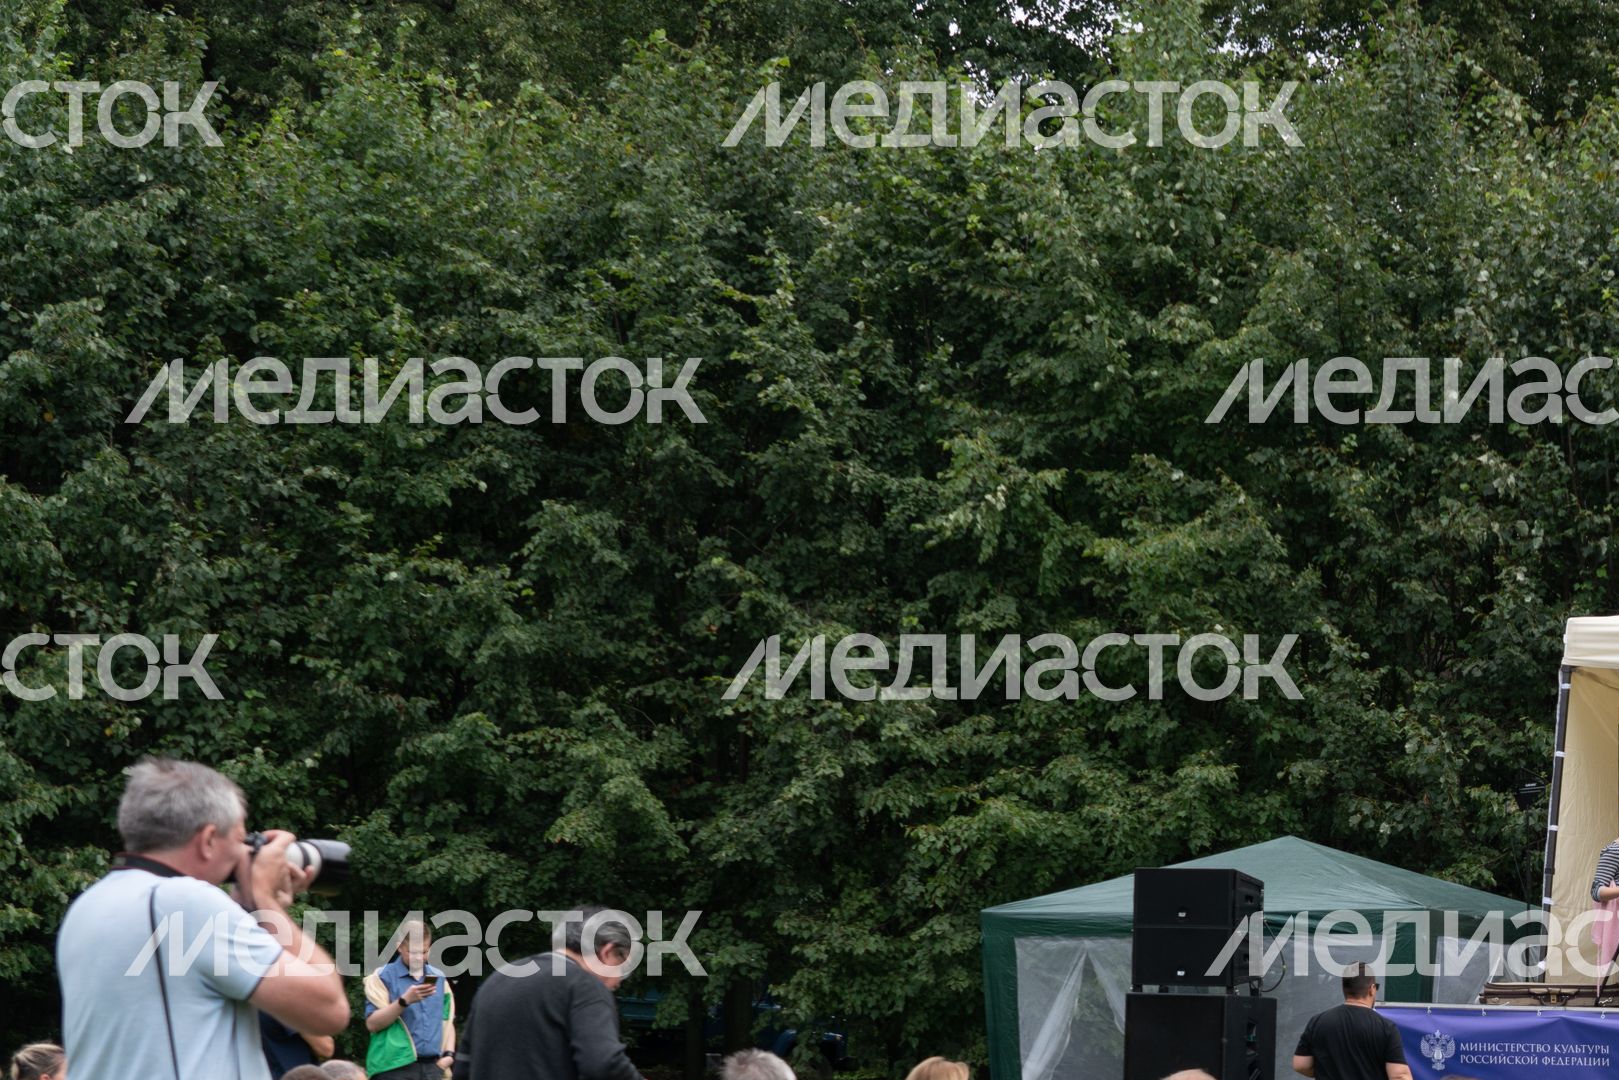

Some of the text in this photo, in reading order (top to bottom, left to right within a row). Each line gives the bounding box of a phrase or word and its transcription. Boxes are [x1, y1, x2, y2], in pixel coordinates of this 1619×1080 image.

[1459, 1042, 1610, 1054] МИНИСТЕРСТВО КУЛЬТУРЫ
[1459, 1053, 1610, 1067] РОССИЙСКОЙ ФЕДЕРАЦИИ
